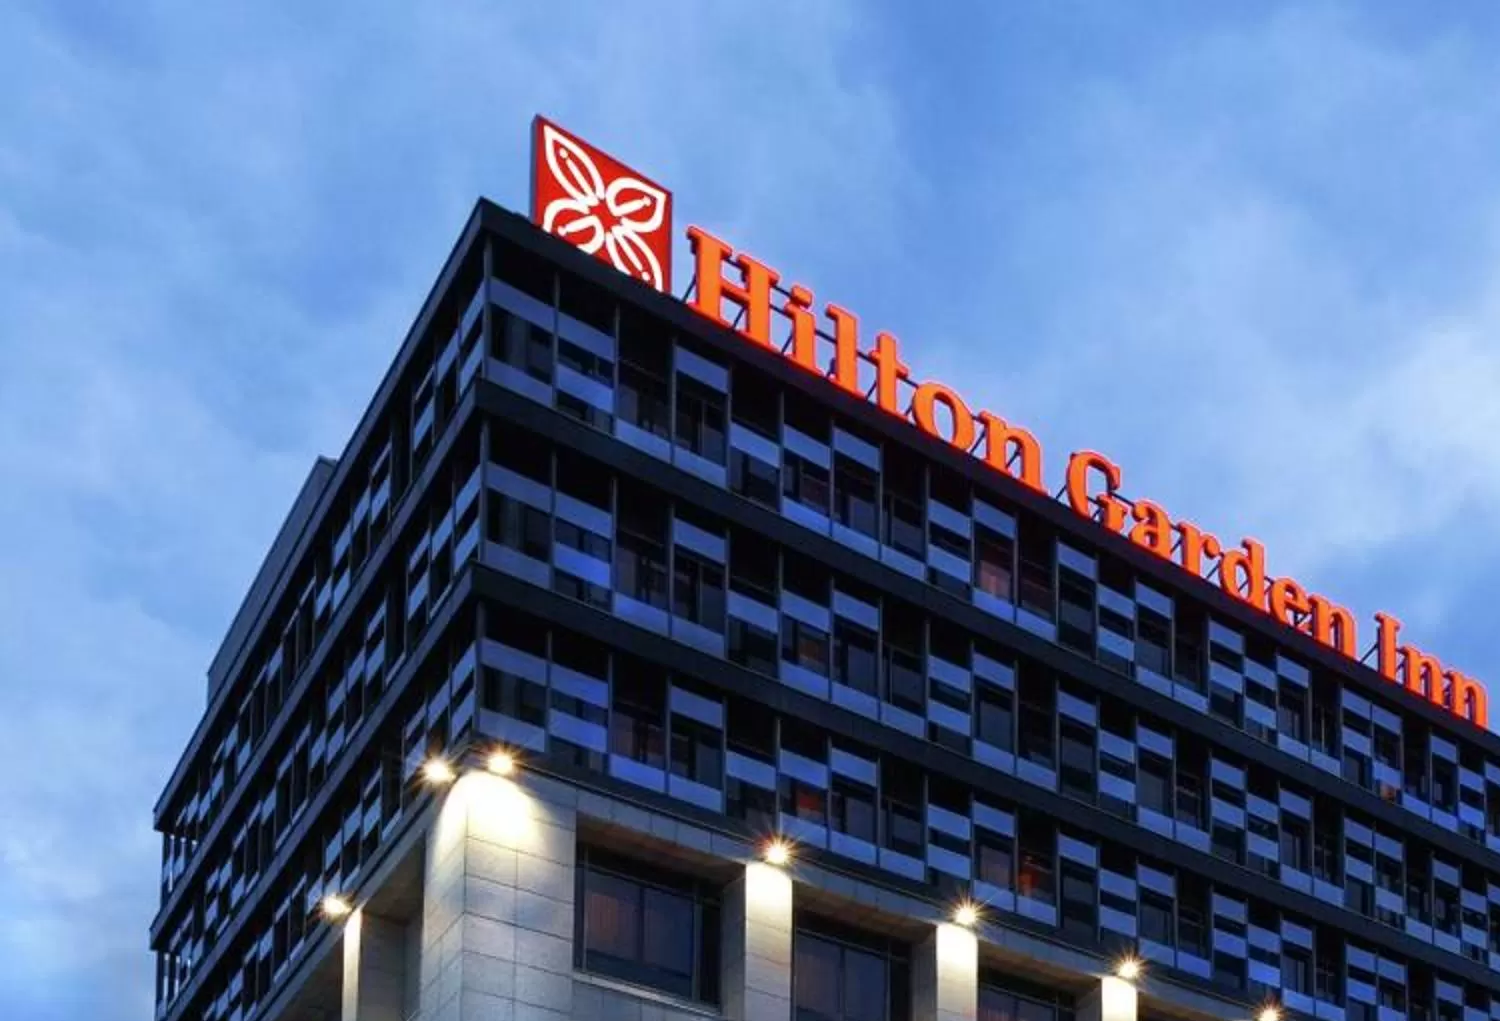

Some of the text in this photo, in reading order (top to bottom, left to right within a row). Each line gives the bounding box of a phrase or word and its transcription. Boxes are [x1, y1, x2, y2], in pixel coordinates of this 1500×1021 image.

[686, 225, 1489, 731] Hilton Garden Inn
